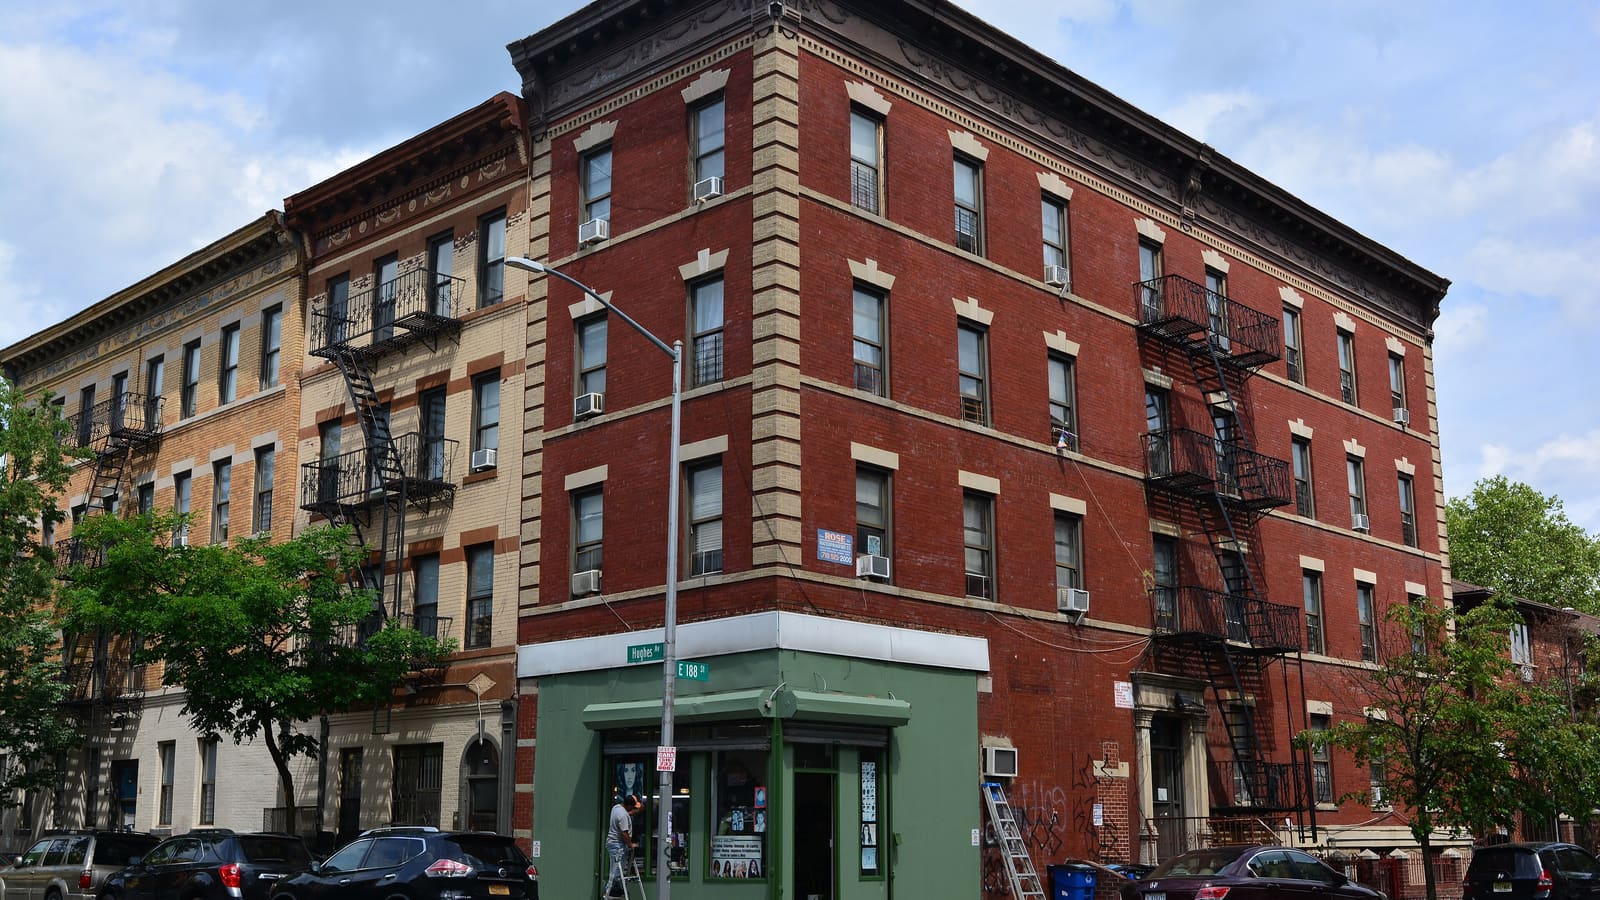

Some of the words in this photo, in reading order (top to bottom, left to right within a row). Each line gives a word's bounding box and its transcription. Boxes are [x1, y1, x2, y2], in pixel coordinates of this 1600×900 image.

[825, 532, 846, 542] ROSE
[632, 648, 653, 660] Hughes
[678, 664, 684, 676] E
[686, 664, 698, 678] 188
